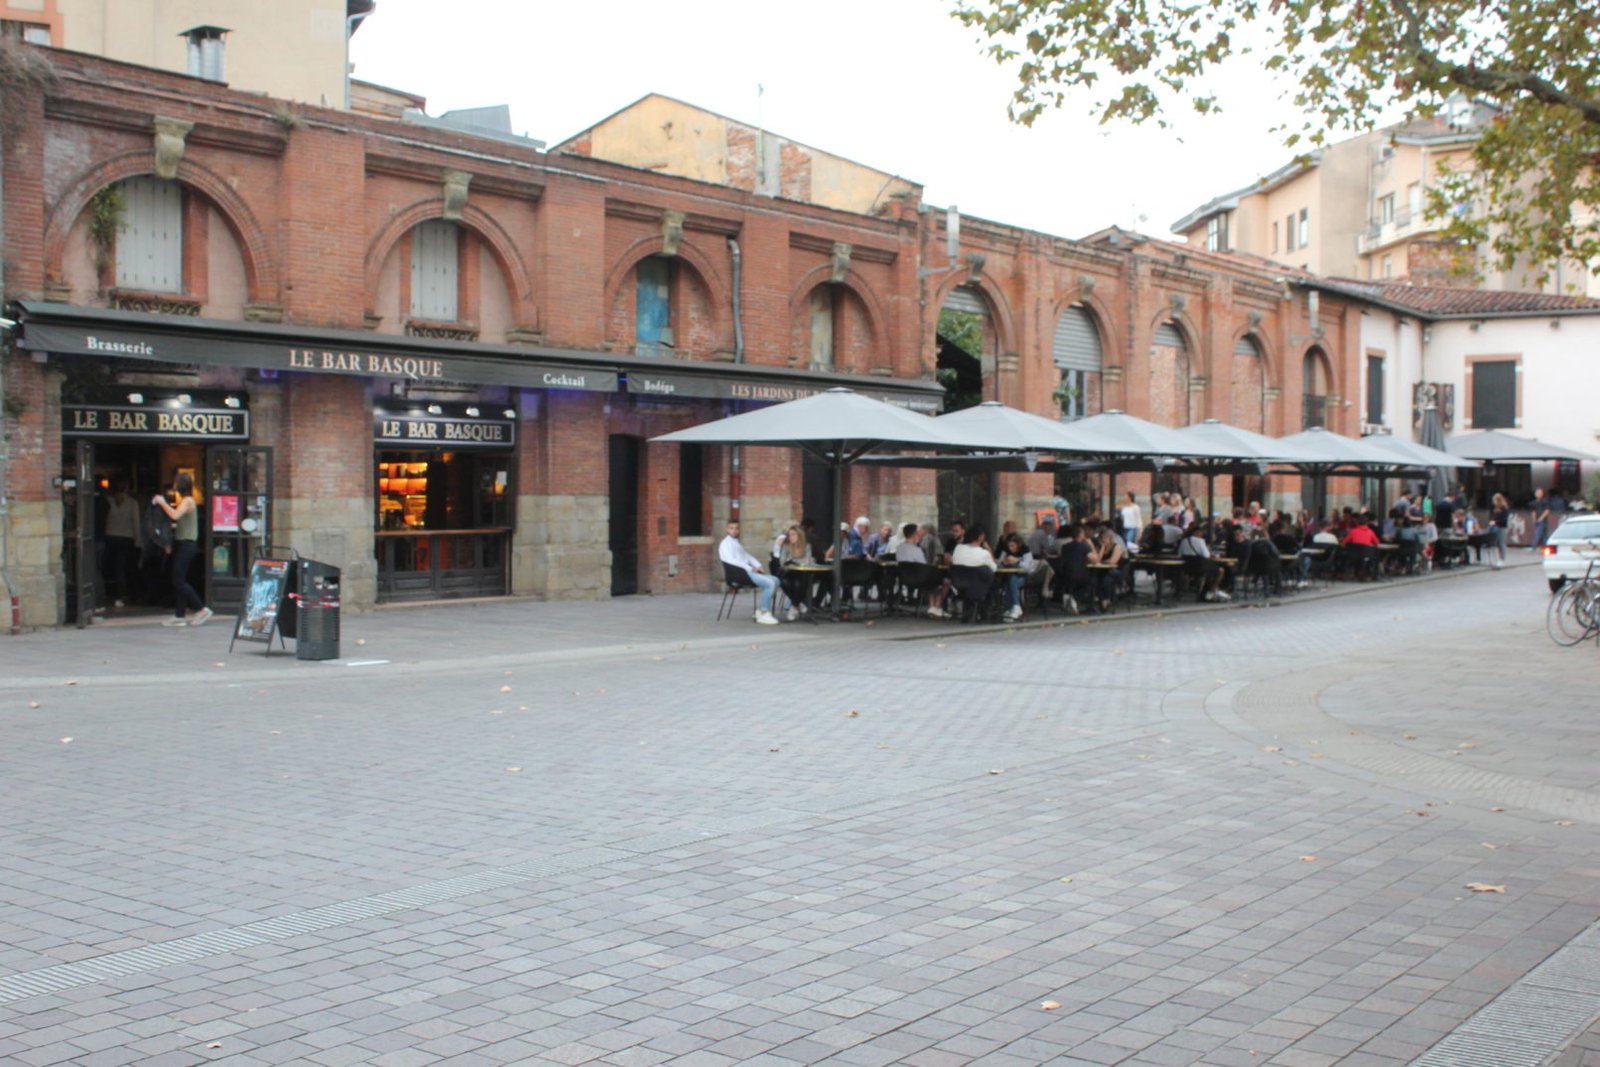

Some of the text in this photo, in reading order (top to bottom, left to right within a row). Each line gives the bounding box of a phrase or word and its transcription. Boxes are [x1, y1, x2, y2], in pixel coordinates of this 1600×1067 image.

[86, 336, 154, 355] Brasserie
[289, 349, 443, 379] LE BAR BASQUE
[543, 373, 585, 387] Cocktail
[731, 384, 750, 397] LES
[752, 386, 794, 400] JARDINS
[74, 411, 233, 433] LE BAR BASQUE
[382, 421, 503, 440] LE BAR BASQUE
